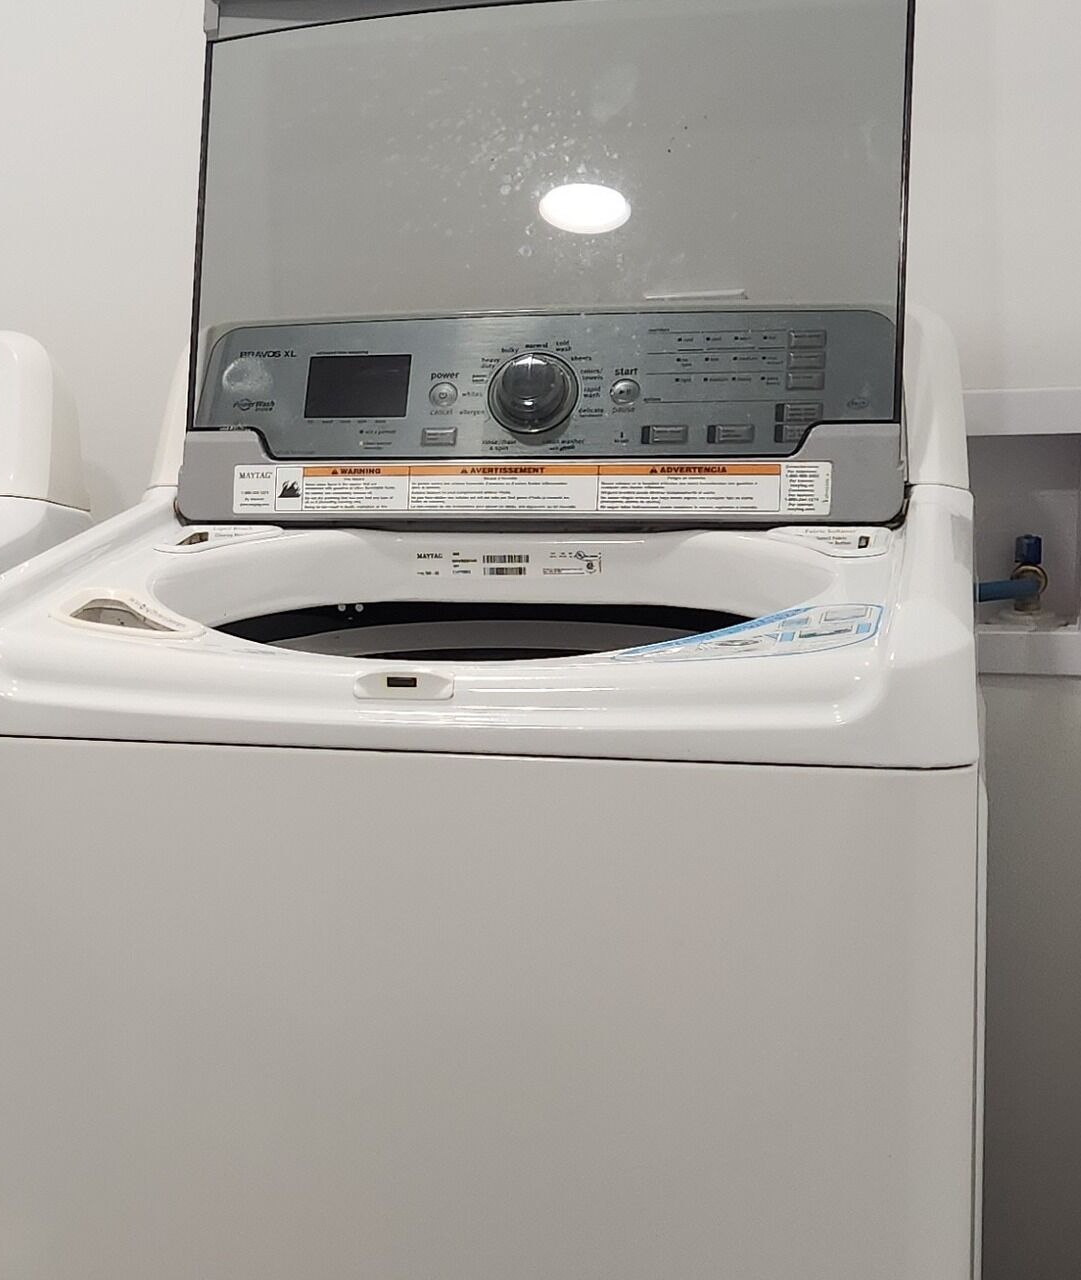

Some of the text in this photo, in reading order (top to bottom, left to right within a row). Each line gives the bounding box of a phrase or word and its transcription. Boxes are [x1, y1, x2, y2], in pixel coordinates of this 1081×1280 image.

[284, 350, 297, 358] XL
[500, 346, 520, 354] bulky
[430, 371, 460, 380] power
[614, 368, 638, 376] start
[611, 407, 636, 415] pause
[659, 466, 728, 474] ADVERTENCIA
[416, 552, 443, 560] MAYTAG
